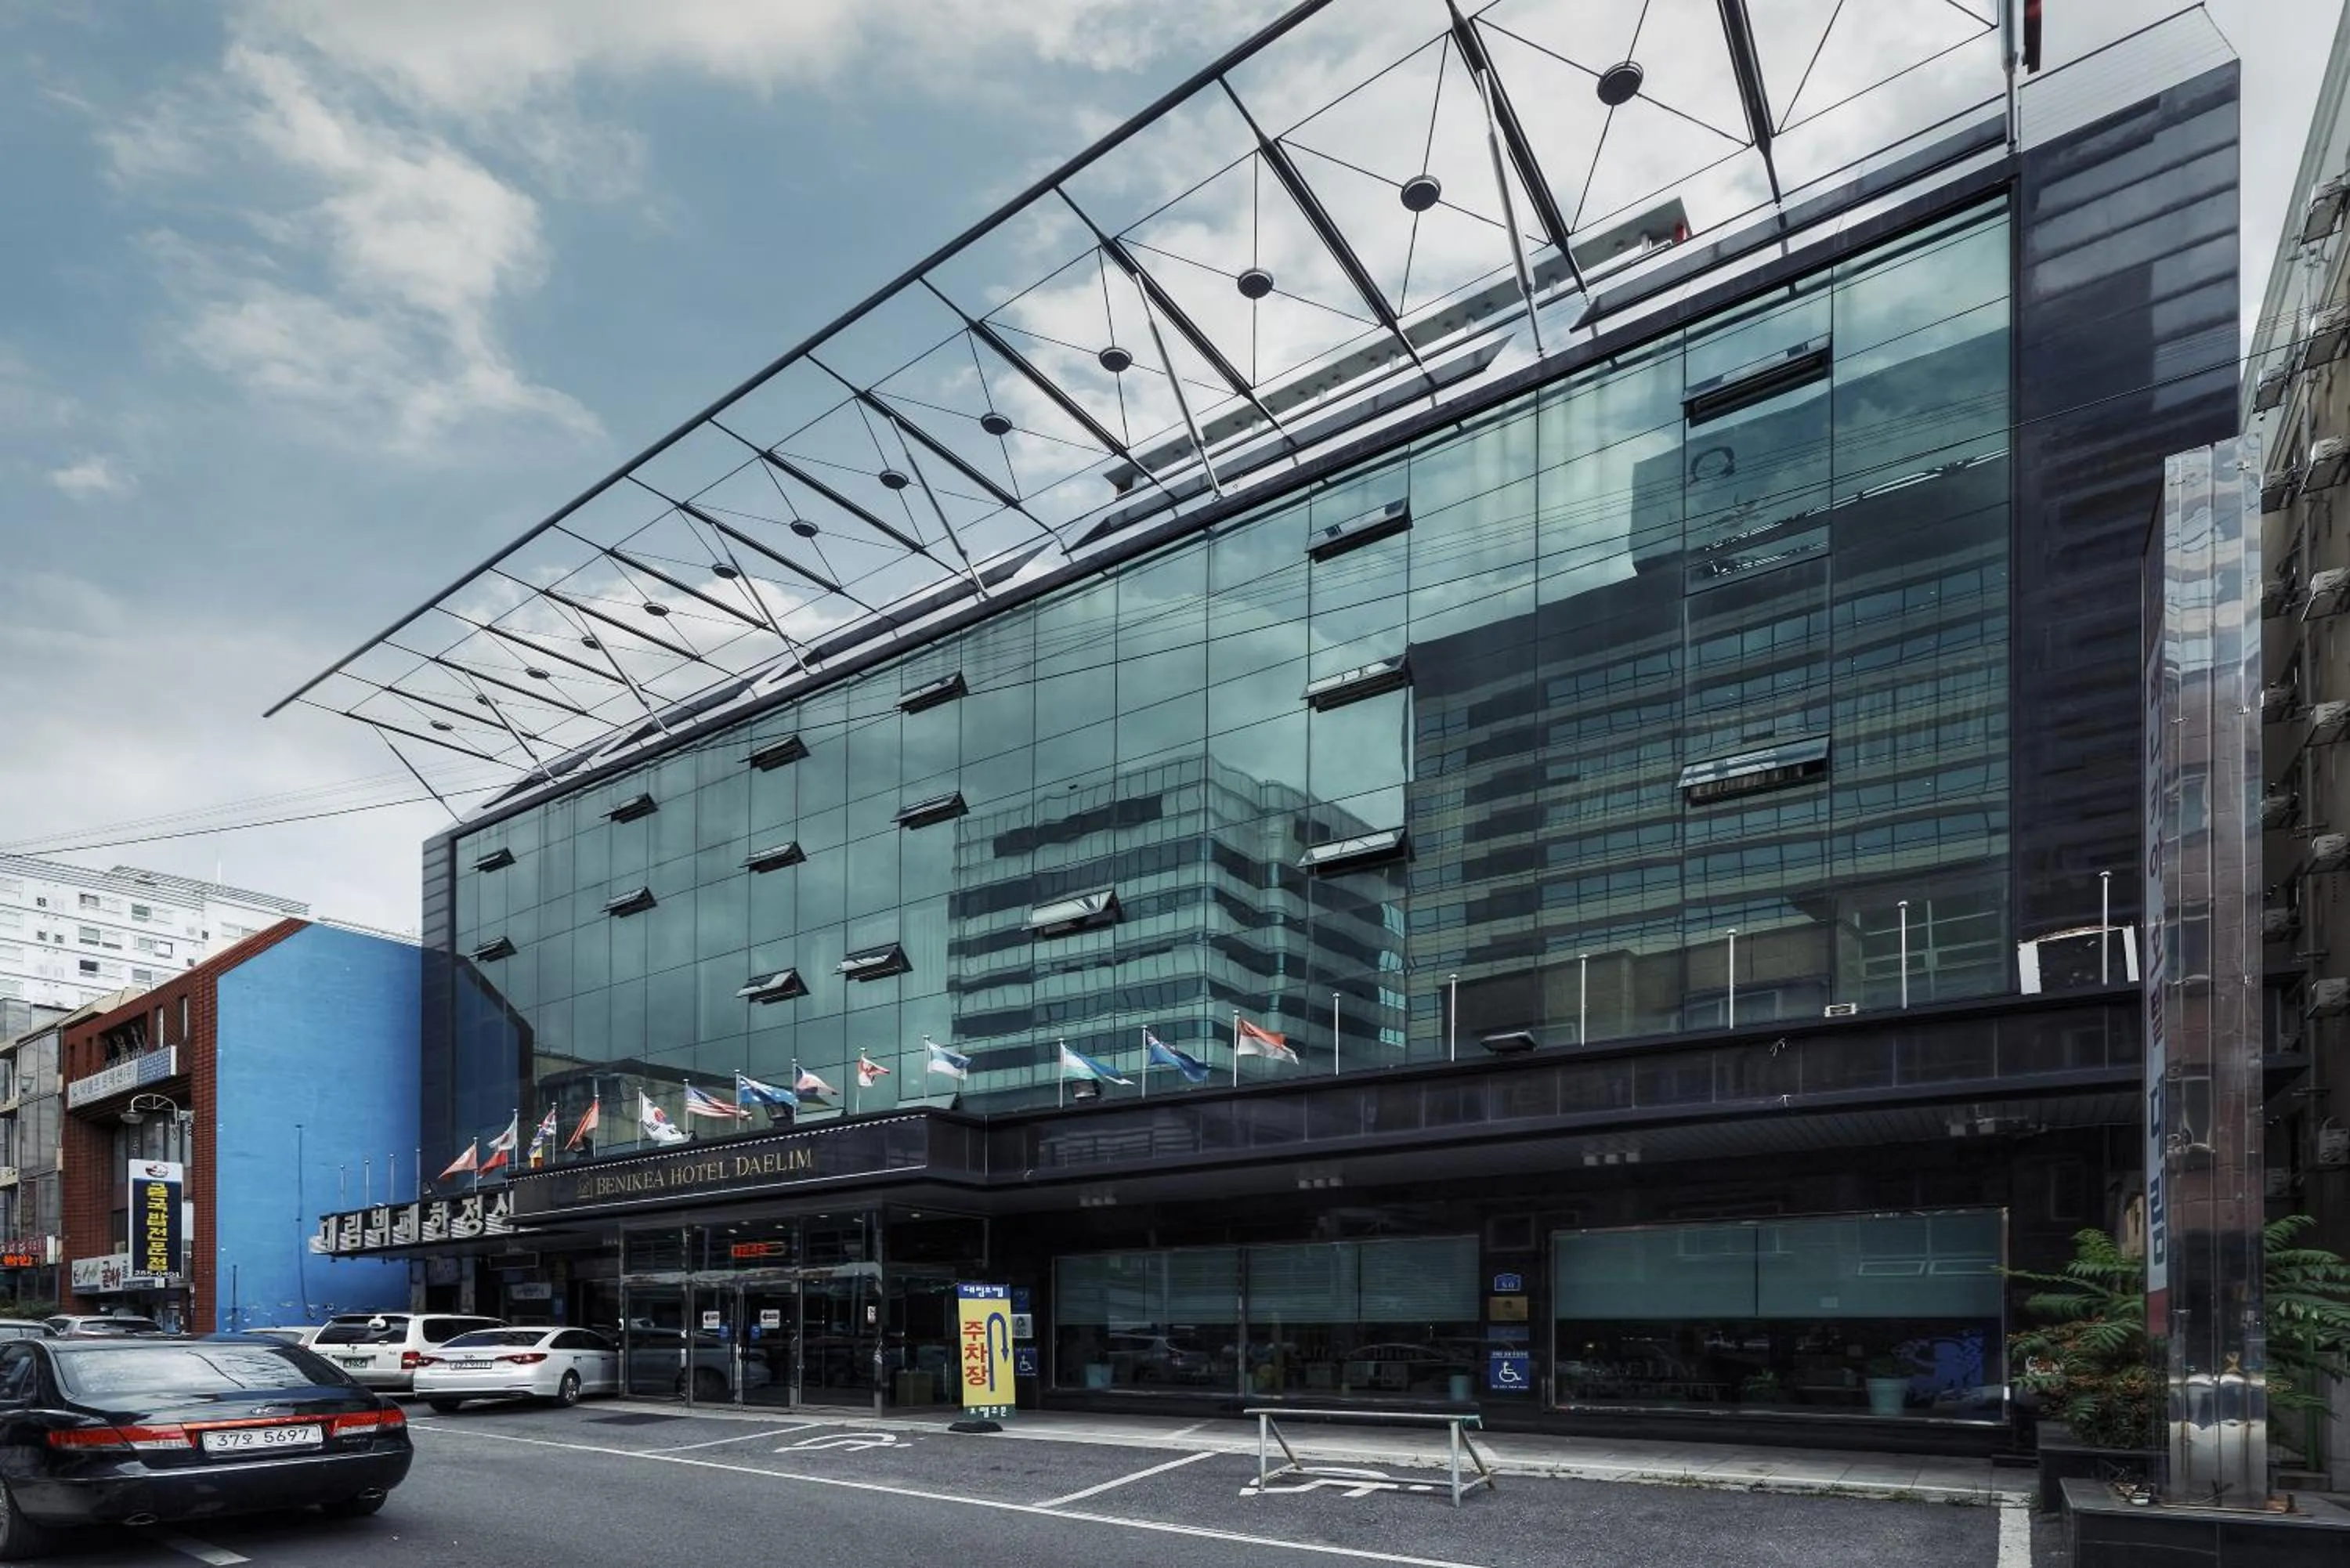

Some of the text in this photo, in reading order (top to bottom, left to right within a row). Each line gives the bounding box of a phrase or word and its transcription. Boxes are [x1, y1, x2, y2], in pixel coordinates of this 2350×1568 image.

[597, 1148, 812, 1196] BENIKEA HOTEL DAELIM
[2149, 1073, 2165, 1266] 대림
[962, 1321, 988, 1386] 주차장
[264, 1429, 309, 1443] 5697
